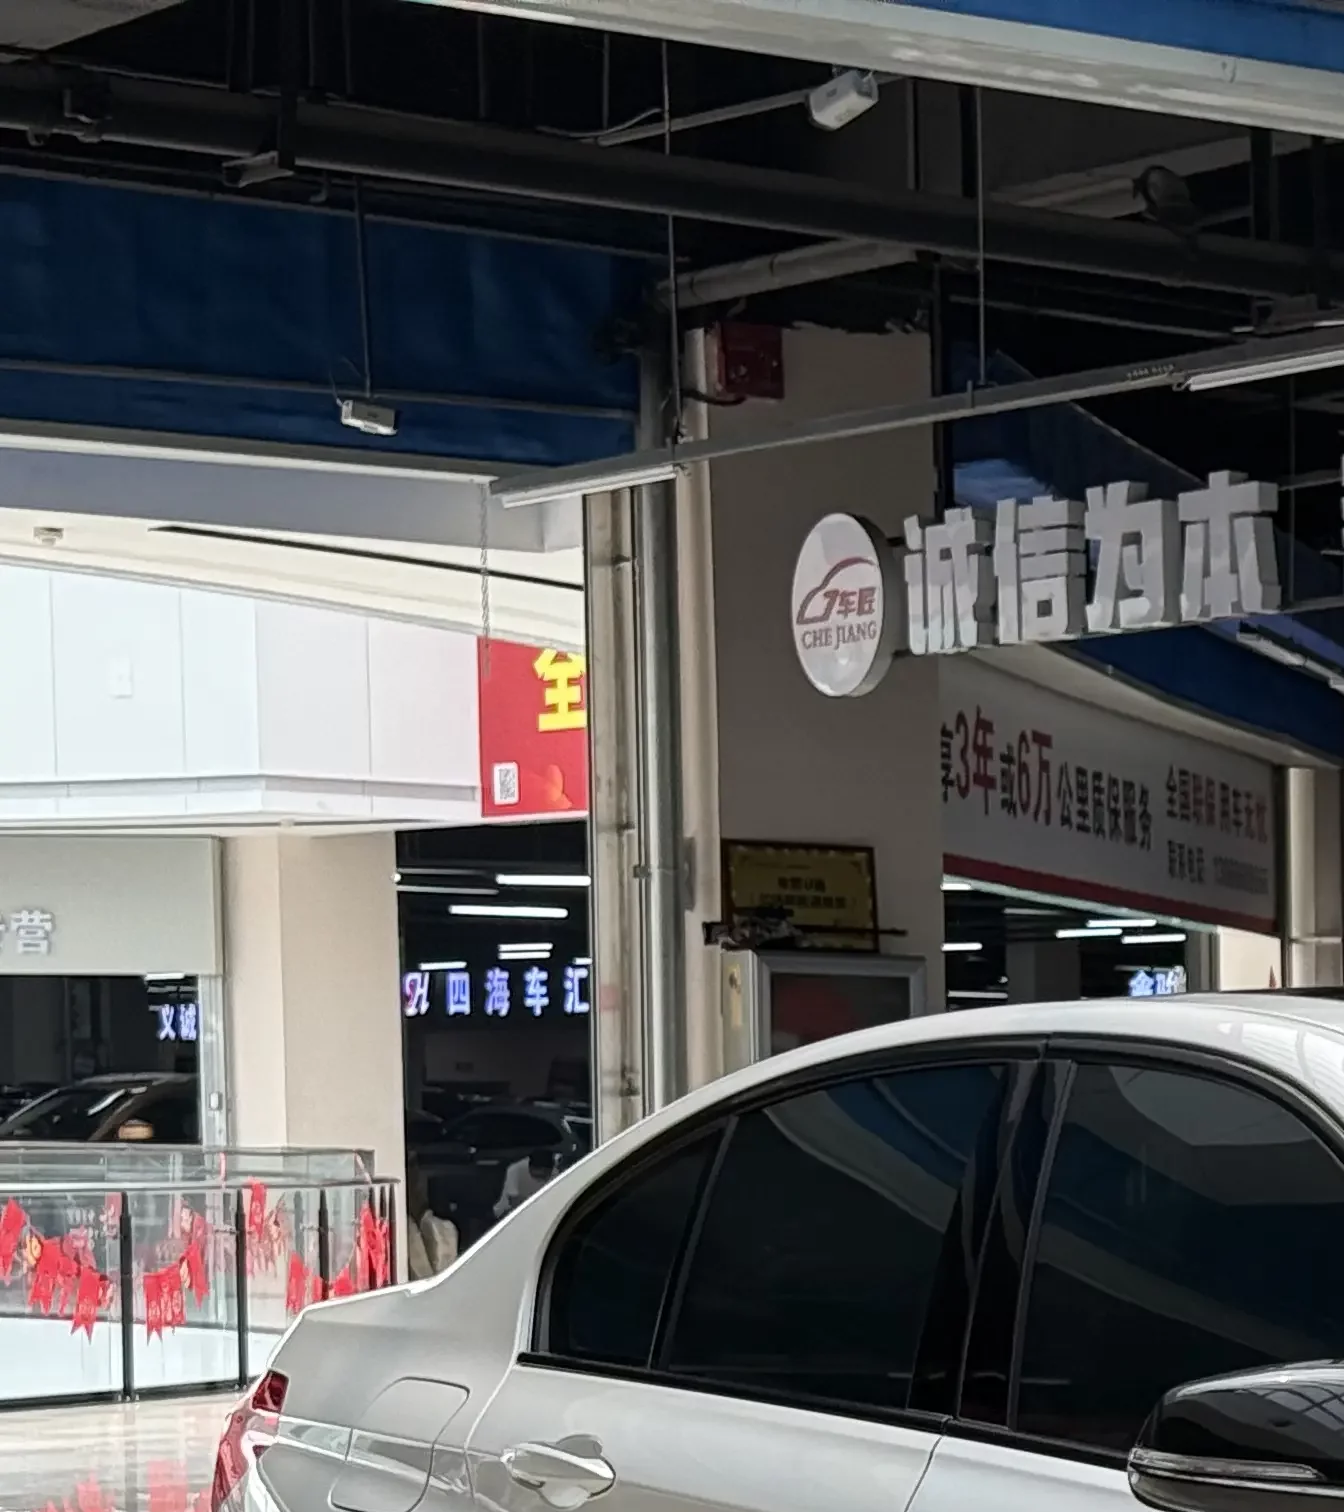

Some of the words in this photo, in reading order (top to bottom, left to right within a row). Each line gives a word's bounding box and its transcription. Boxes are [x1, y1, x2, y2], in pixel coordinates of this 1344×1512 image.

[904, 470, 1281, 656] 诚信为本
[802, 626, 832, 650] CHE
[834, 620, 877, 650] JIANG
[533, 648, 588, 731] 全
[0, 909, 53, 955] 营
[446, 966, 590, 1017] 四海车汇
